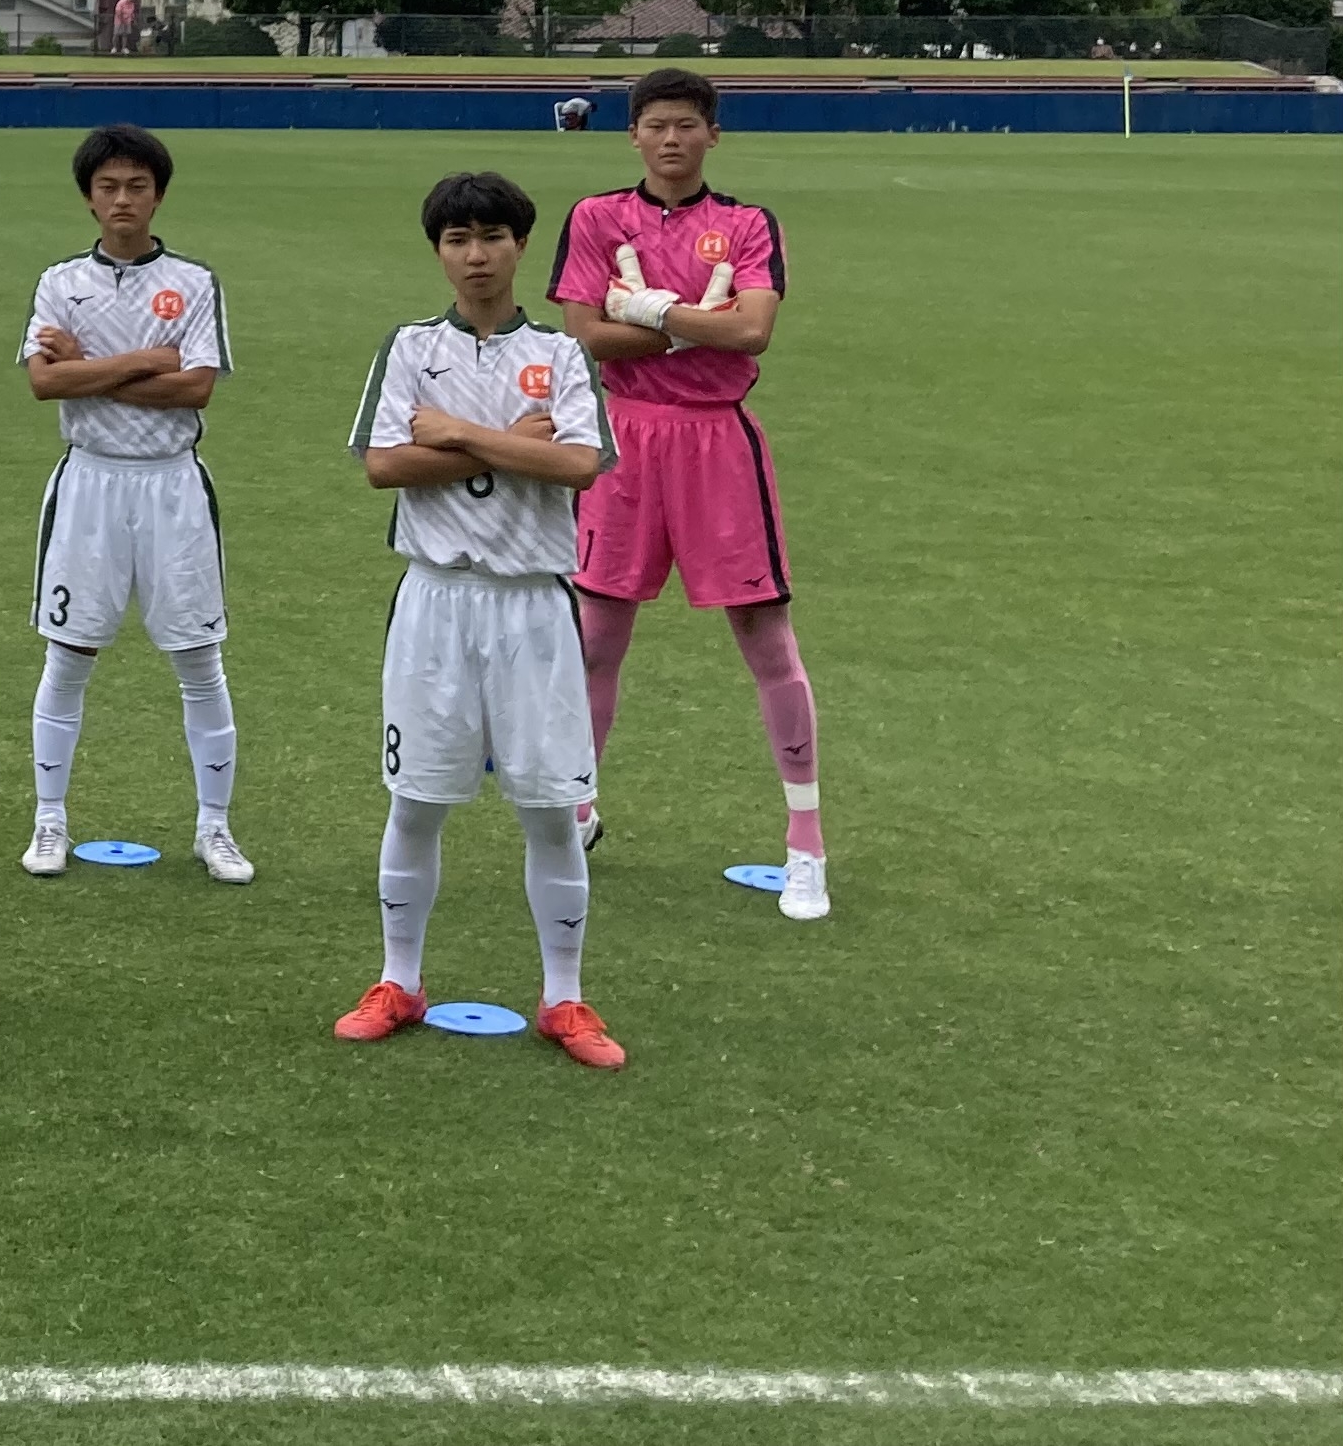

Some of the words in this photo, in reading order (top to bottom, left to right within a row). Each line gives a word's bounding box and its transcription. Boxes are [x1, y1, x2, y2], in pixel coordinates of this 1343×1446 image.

[581, 529, 594, 572] 1
[49, 585, 70, 627] 3
[386, 723, 401, 775] 8
